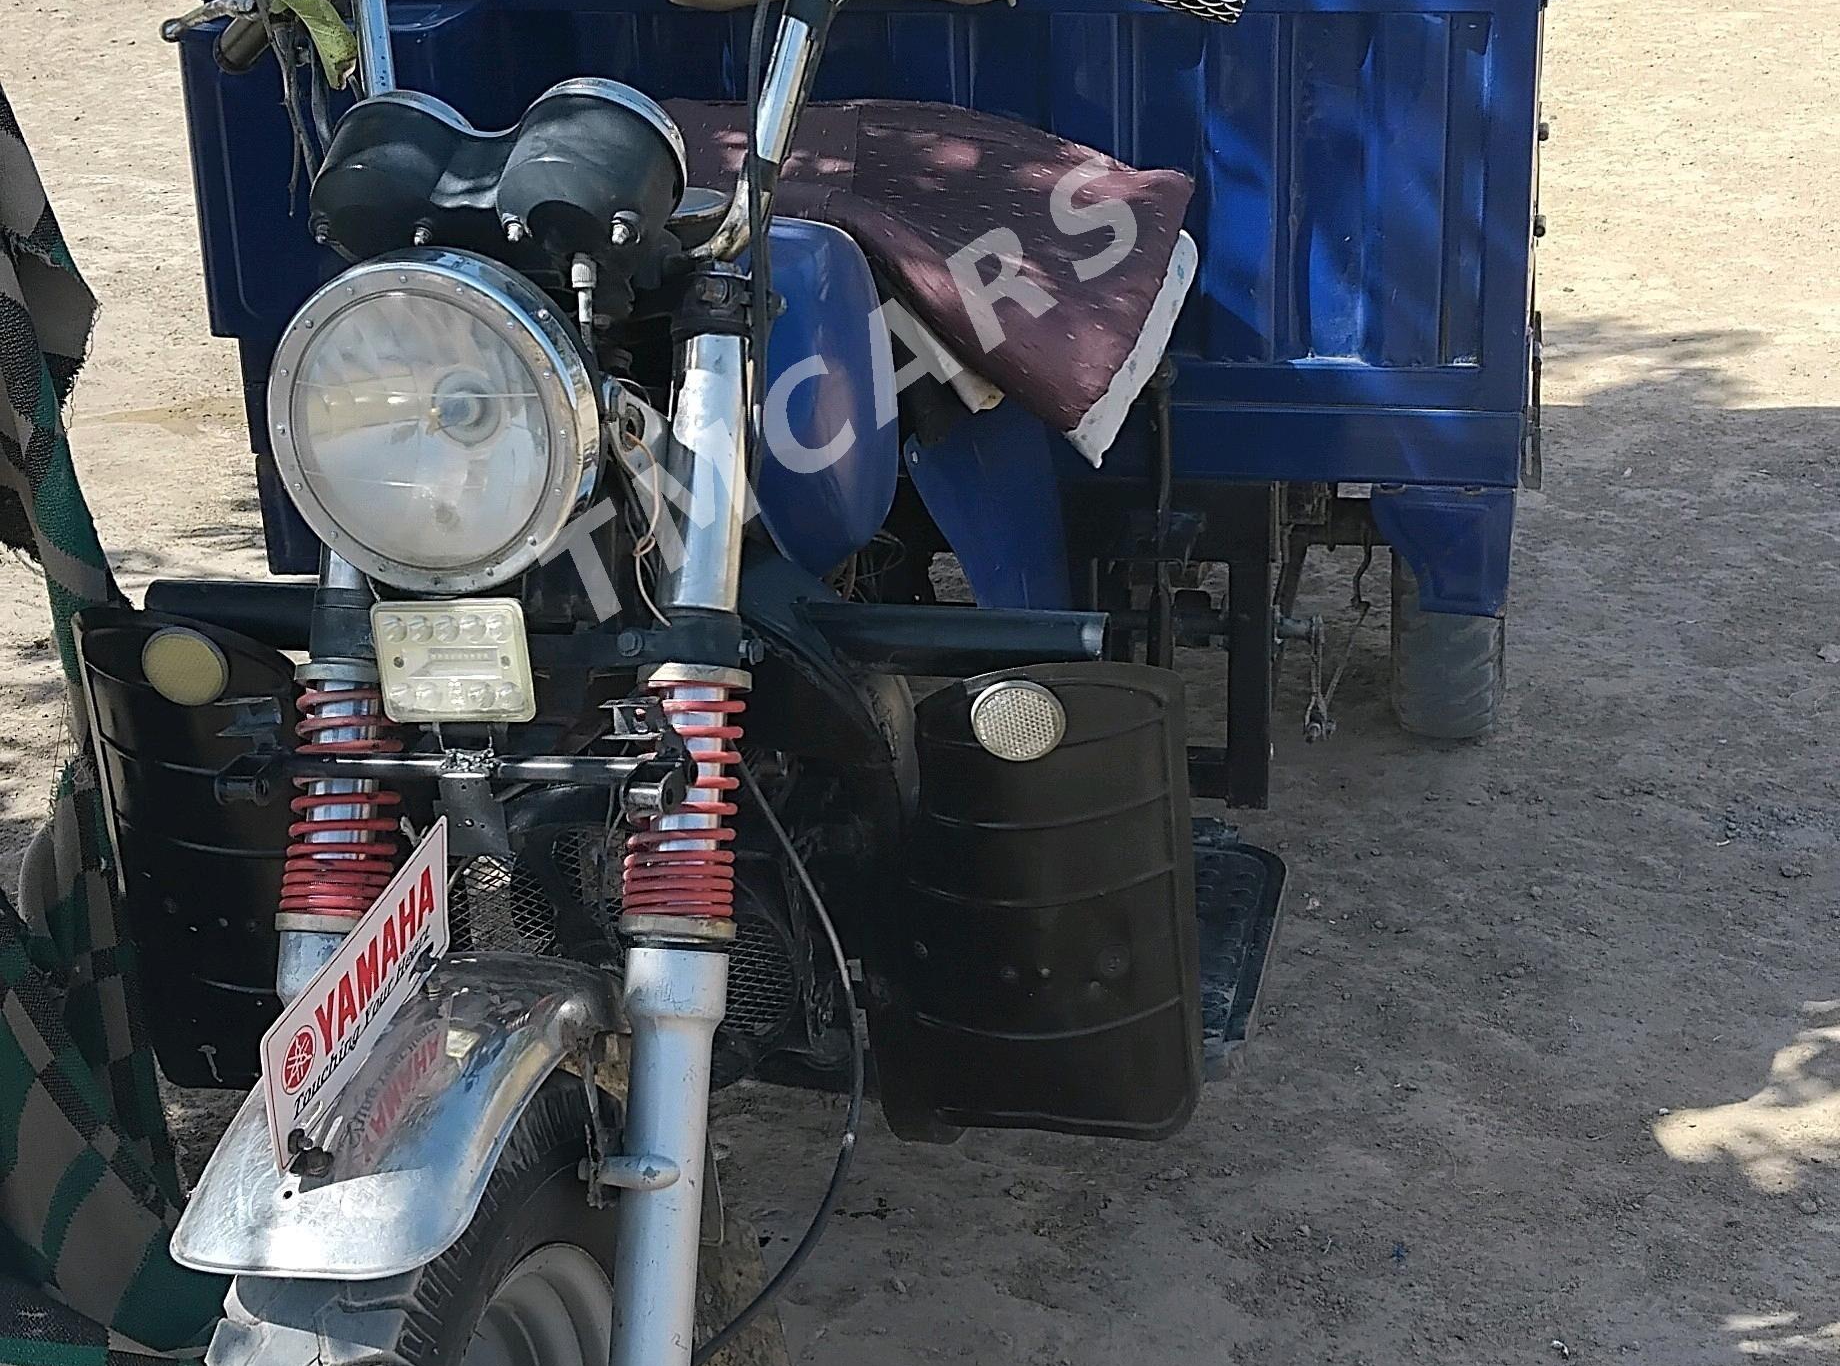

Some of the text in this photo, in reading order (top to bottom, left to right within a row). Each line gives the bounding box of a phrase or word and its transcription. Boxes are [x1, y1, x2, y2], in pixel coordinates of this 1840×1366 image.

[314, 865, 434, 1057] YAMAHA
[293, 1023, 361, 1121] Touching
[363, 978, 394, 1029] Your
